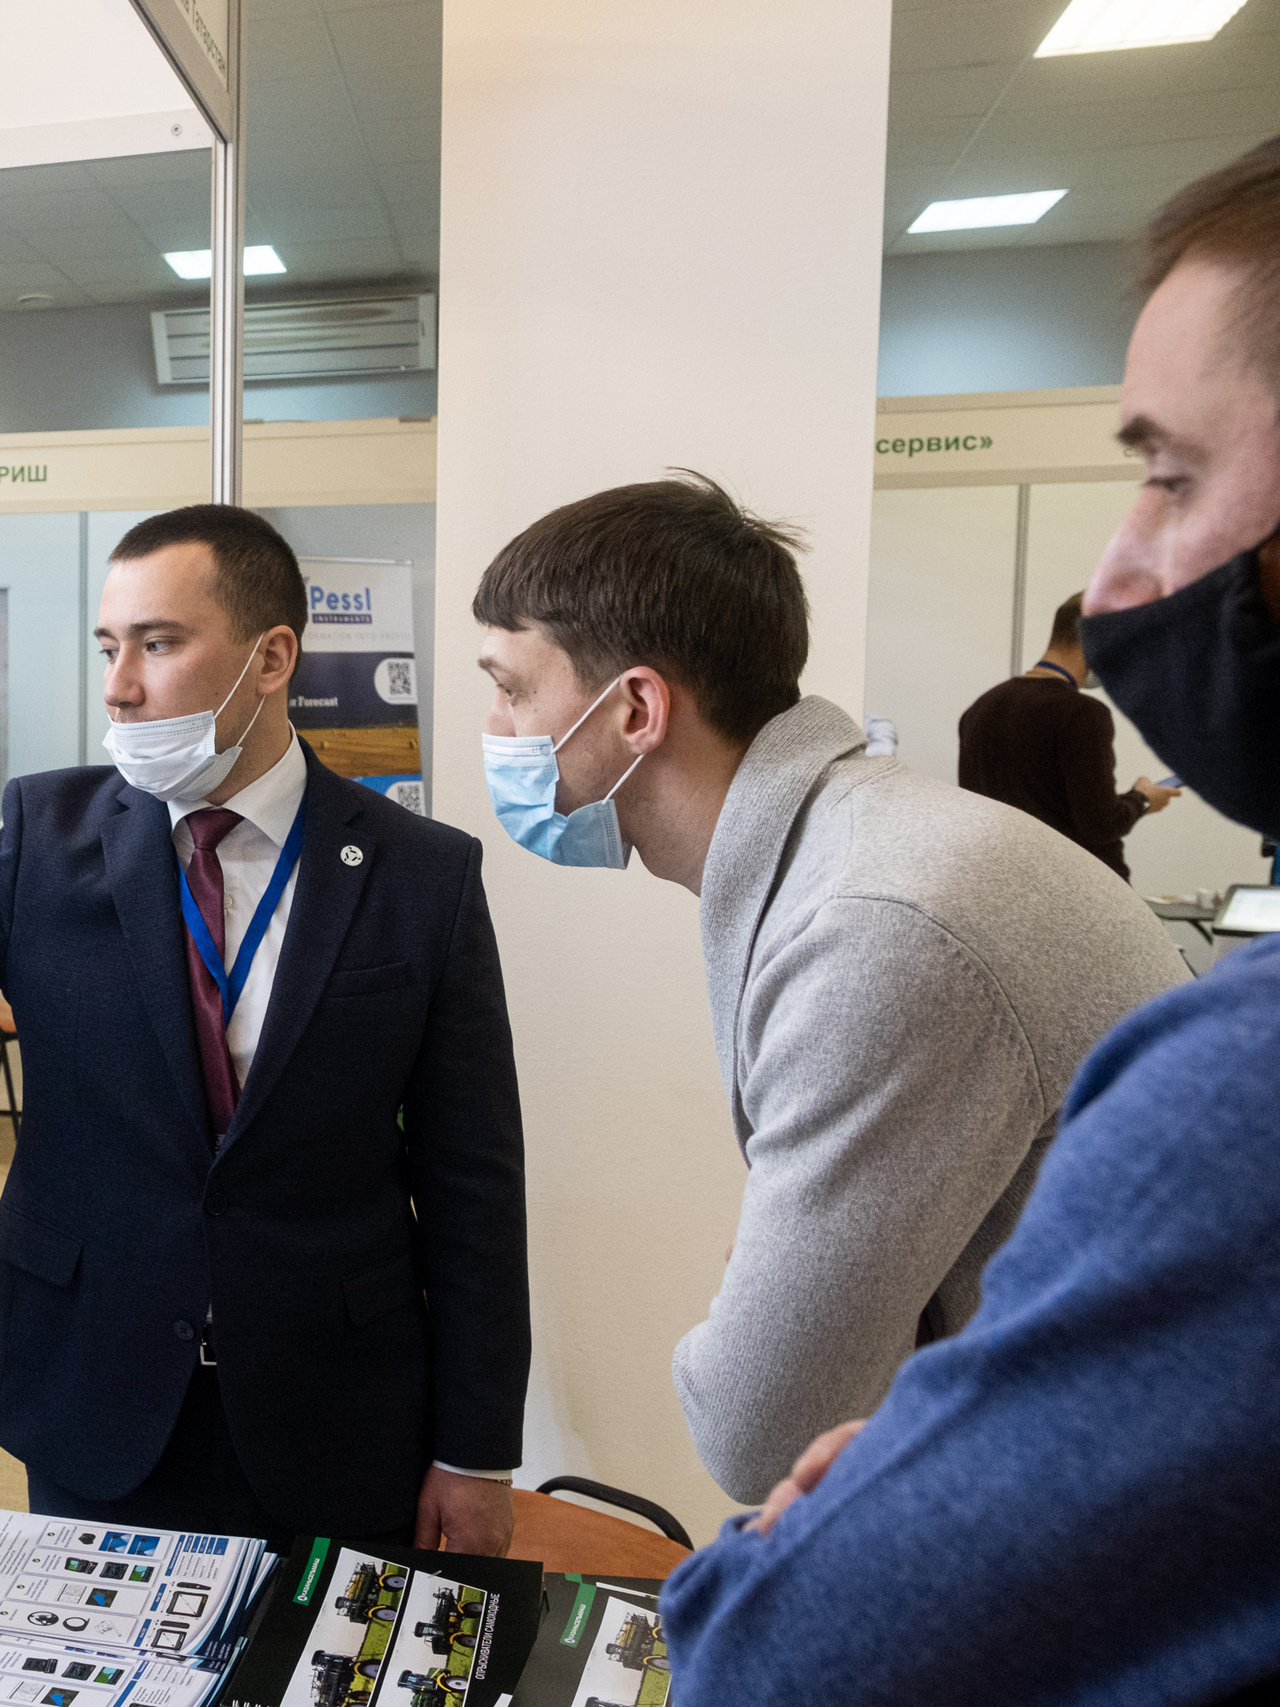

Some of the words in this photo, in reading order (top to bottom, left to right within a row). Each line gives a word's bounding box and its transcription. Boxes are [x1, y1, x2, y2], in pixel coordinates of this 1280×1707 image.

[310, 585, 372, 611] Pessl
[475, 1632, 493, 1681] ОПРЫСКИВАТЕЛИ
[485, 1592, 501, 1633] САМОХОДНЫЕ
